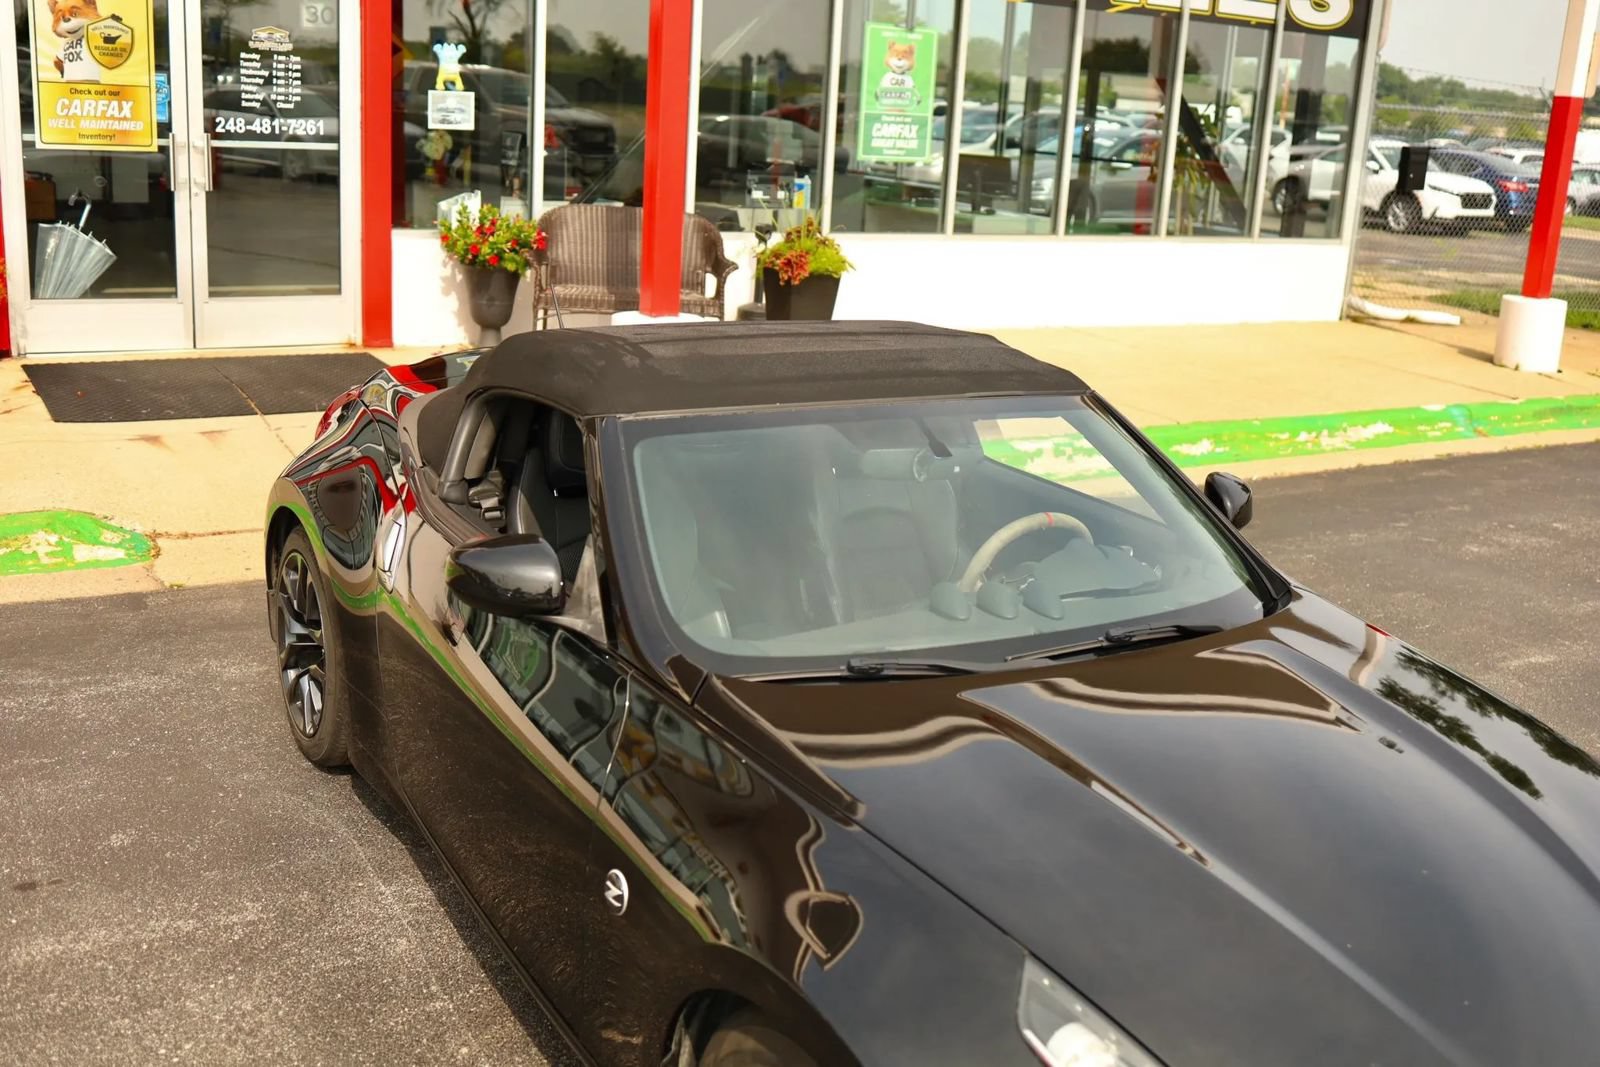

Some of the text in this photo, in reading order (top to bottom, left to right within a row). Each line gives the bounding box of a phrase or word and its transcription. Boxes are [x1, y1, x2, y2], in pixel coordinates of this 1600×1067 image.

[306, 5, 335, 25] 30
[64, 38, 83, 52] CAR
[64, 50, 84, 63] FOX
[69, 87, 121, 97] Check out our
[56, 97, 134, 119] CARFAX
[48, 117, 144, 132] WELL MAINTAINED
[215, 116, 325, 136] 248-481-7261
[871, 122, 919, 139] CARFAX
[78, 132, 116, 142] Inventory!
